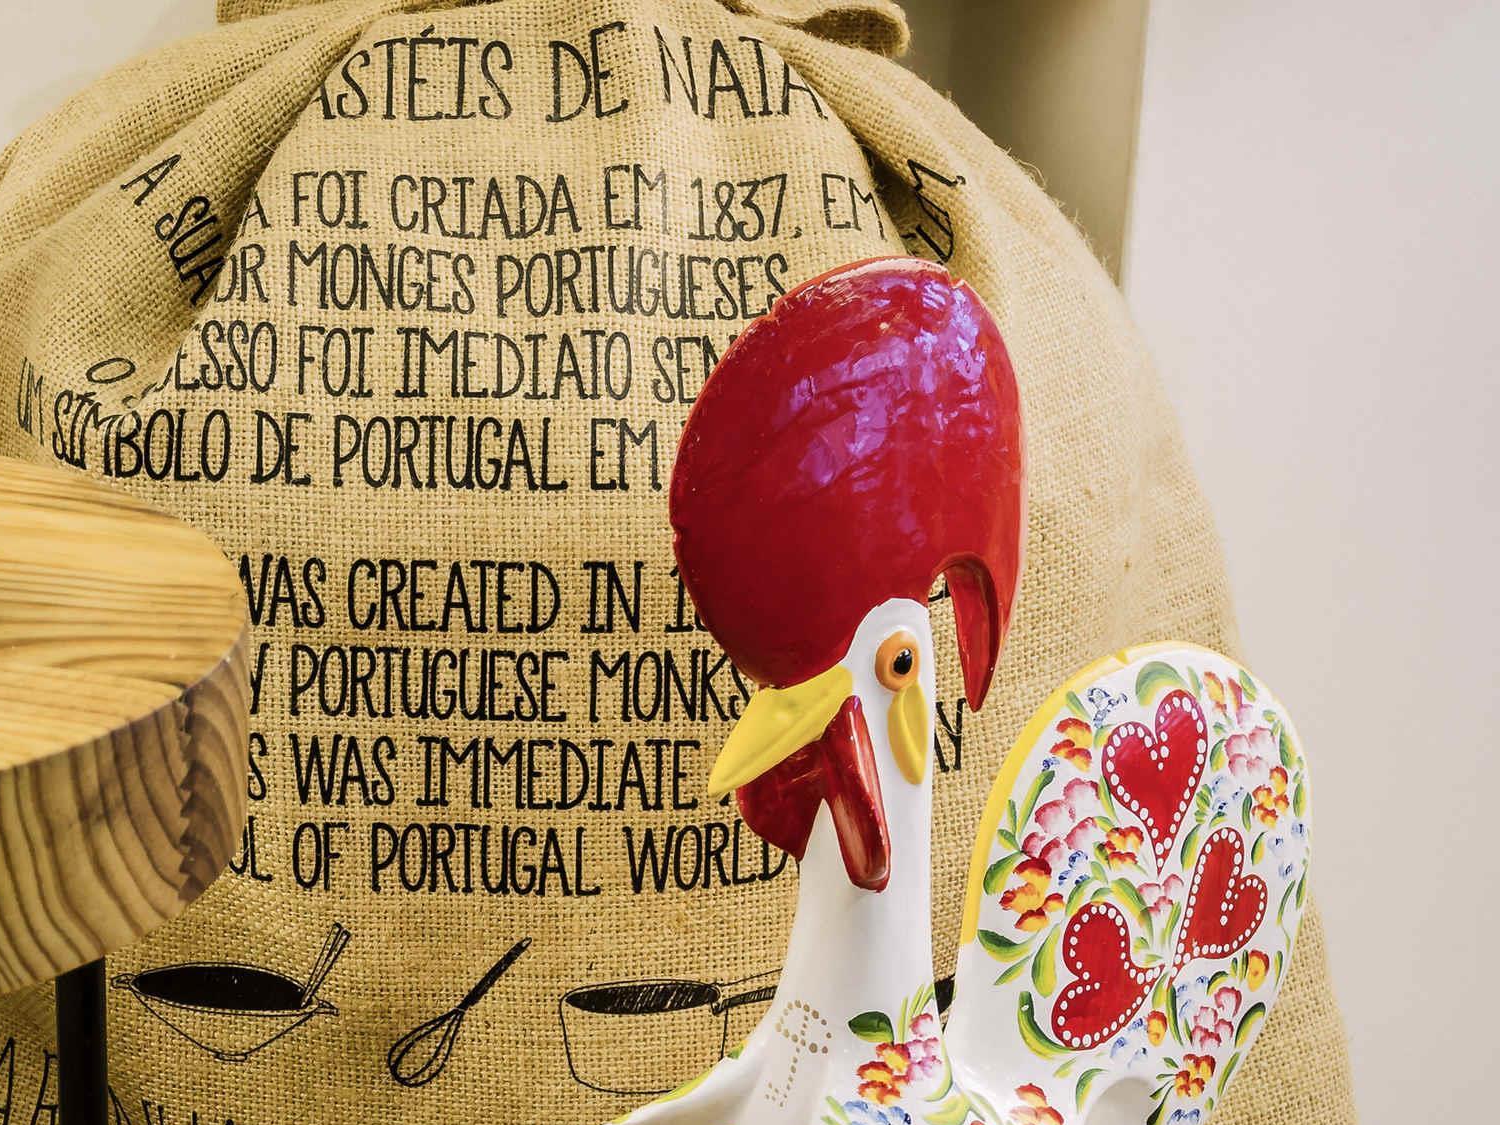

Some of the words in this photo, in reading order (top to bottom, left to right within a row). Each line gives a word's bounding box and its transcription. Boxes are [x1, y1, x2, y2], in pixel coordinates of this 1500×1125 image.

[546, 22, 631, 122] DE
[291, 170, 370, 230] FOI
[390, 173, 583, 241] CRIADA
[604, 164, 668, 231] EM
[687, 172, 802, 242] 1837,
[820, 172, 888, 241] EM
[287, 239, 476, 315] MONGES
[497, 244, 788, 321] PORTUGUESES
[298, 326, 375, 399] FOI
[395, 326, 632, 401] IMEDIATO
[250, 410, 313, 486] DE
[332, 414, 568, 492] PORTUGAL
[590, 417, 663, 492] EM
[347, 557, 561, 634] CREATED
[579, 560, 644, 635] IN
[289, 643, 570, 724] PORTUGUESE
[289, 732, 398, 808] WAS
[416, 735, 701, 811] IMMEDIATE
[292, 821, 350, 894] OF
[370, 821, 601, 898] PORTUGAL
